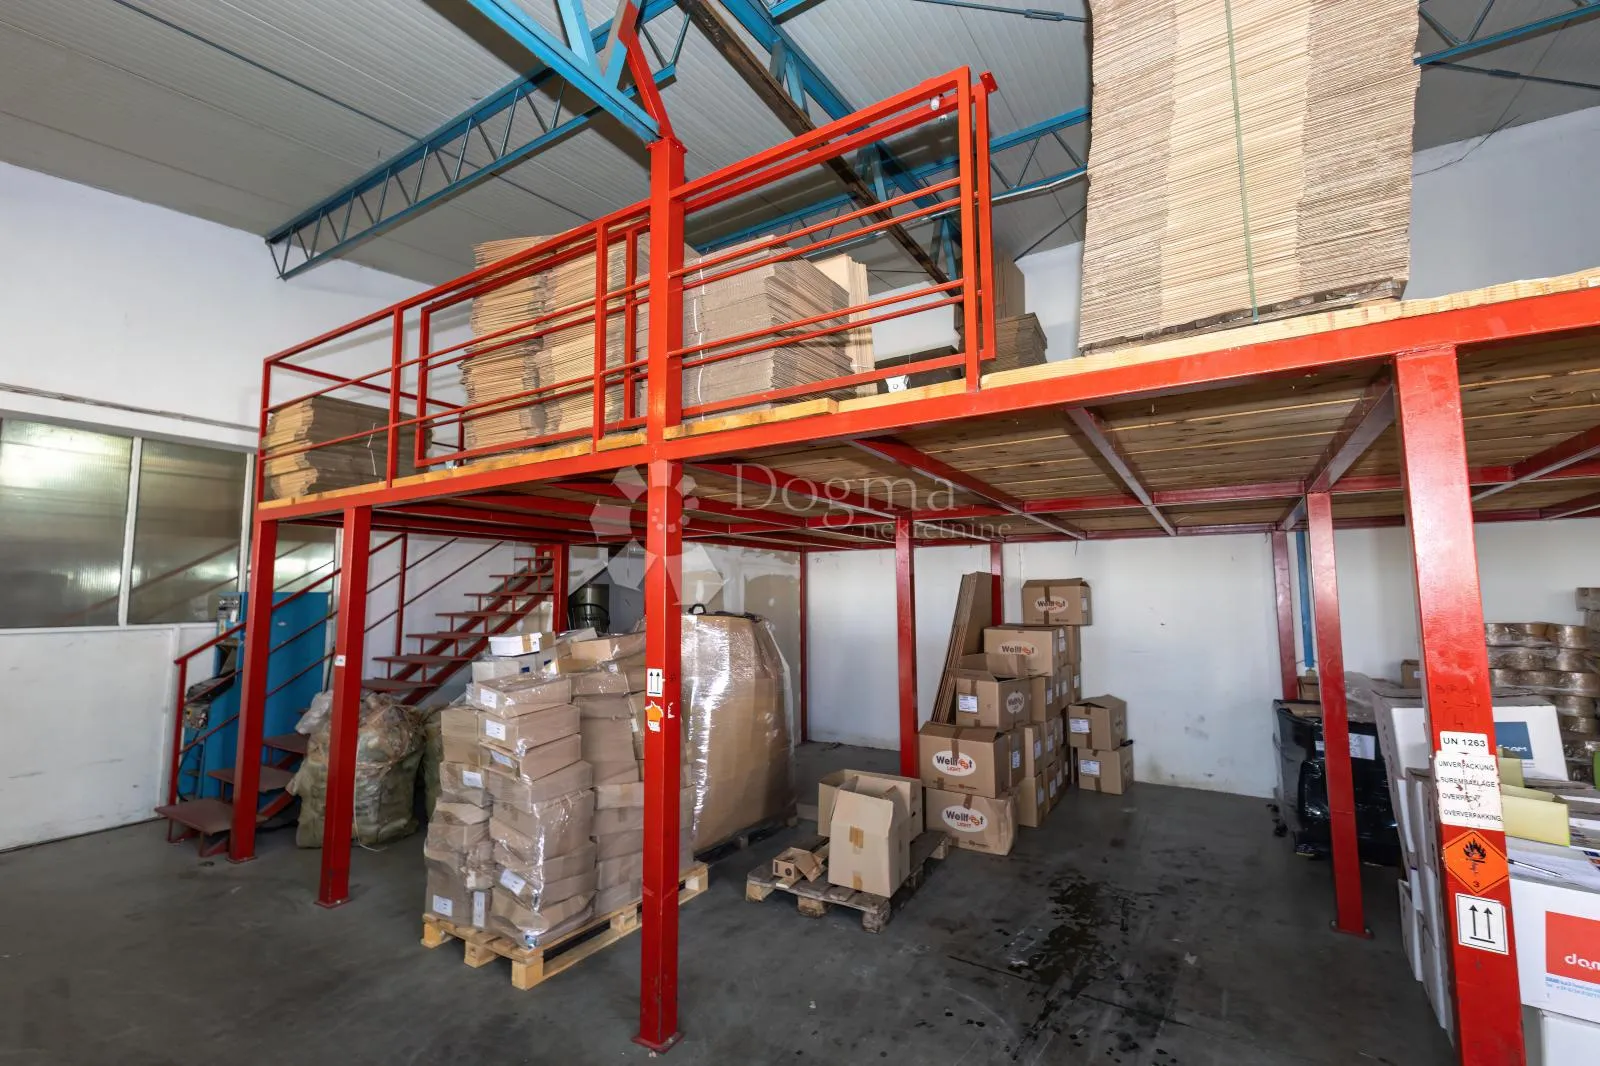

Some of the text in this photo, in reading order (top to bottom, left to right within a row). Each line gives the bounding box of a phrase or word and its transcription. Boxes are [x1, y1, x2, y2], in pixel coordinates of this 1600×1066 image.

[1443, 737, 1486, 747] UN 1263
[1438, 760, 1494, 771] UMVERPACKUNG
[1472, 880, 1480, 888] 3
